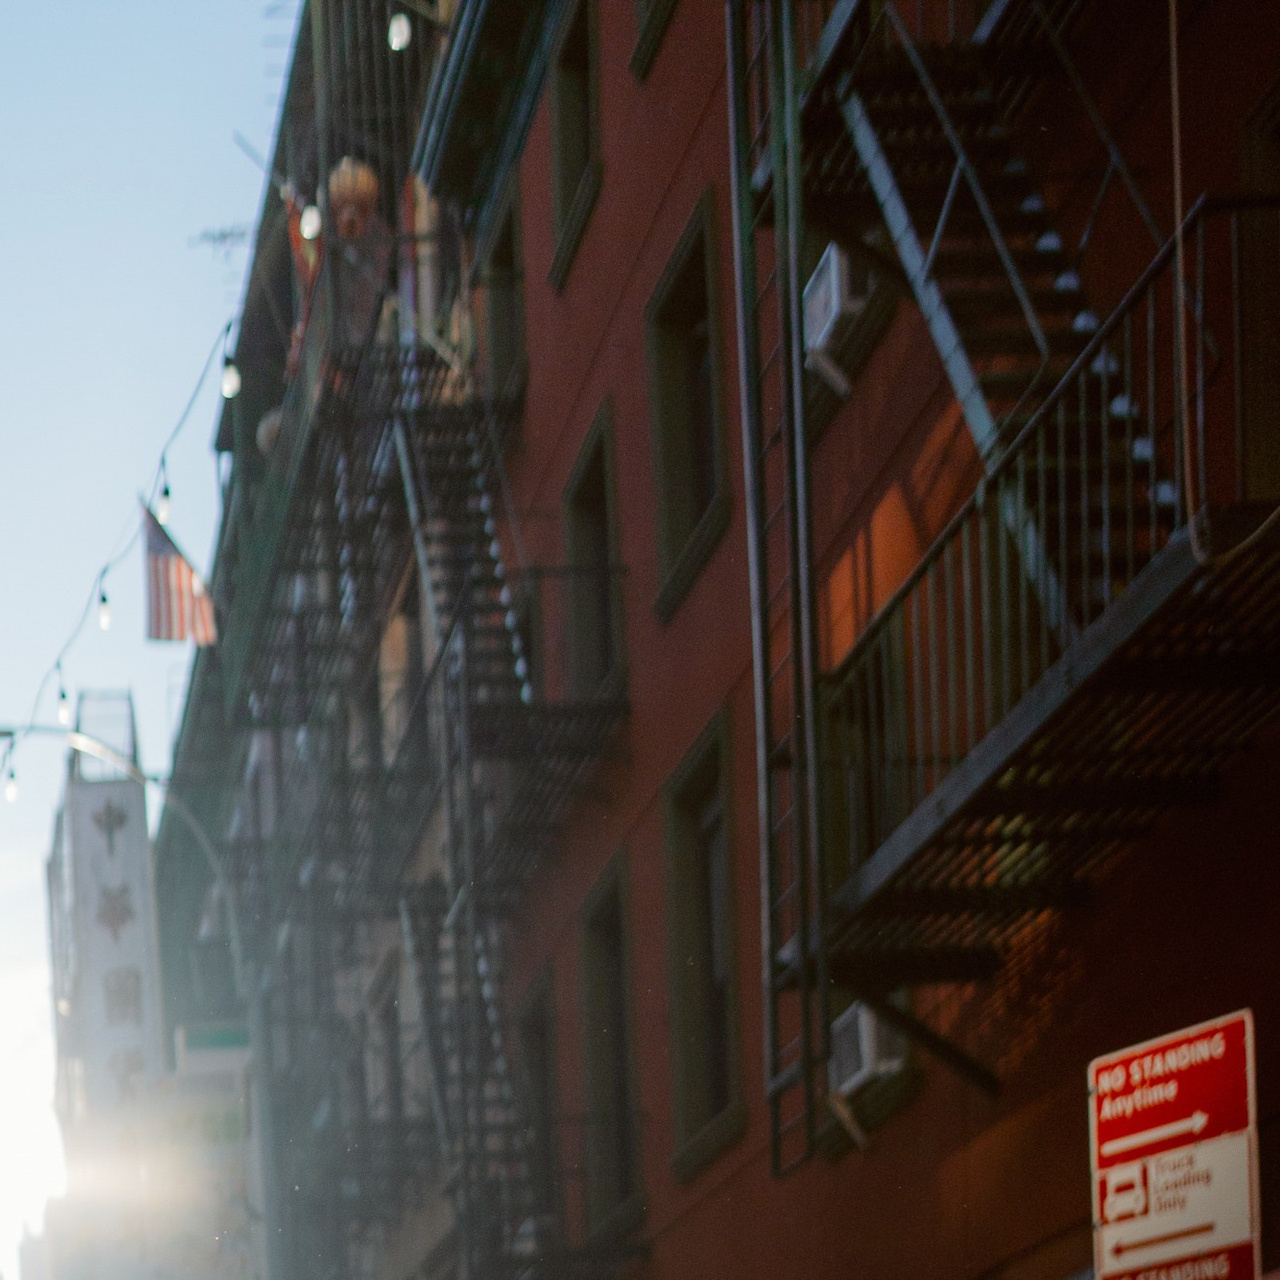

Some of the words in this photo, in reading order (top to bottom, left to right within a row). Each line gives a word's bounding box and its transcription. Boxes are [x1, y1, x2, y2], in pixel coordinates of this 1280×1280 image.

[1098, 1065, 1126, 1095] NO
[1130, 1033, 1225, 1082] STANDING
[1100, 1080, 1178, 1121] Anytime
[1154, 1152, 1195, 1175] Truck
[1153, 1169, 1212, 1194] Loading
[1154, 1192, 1187, 1215] Only
